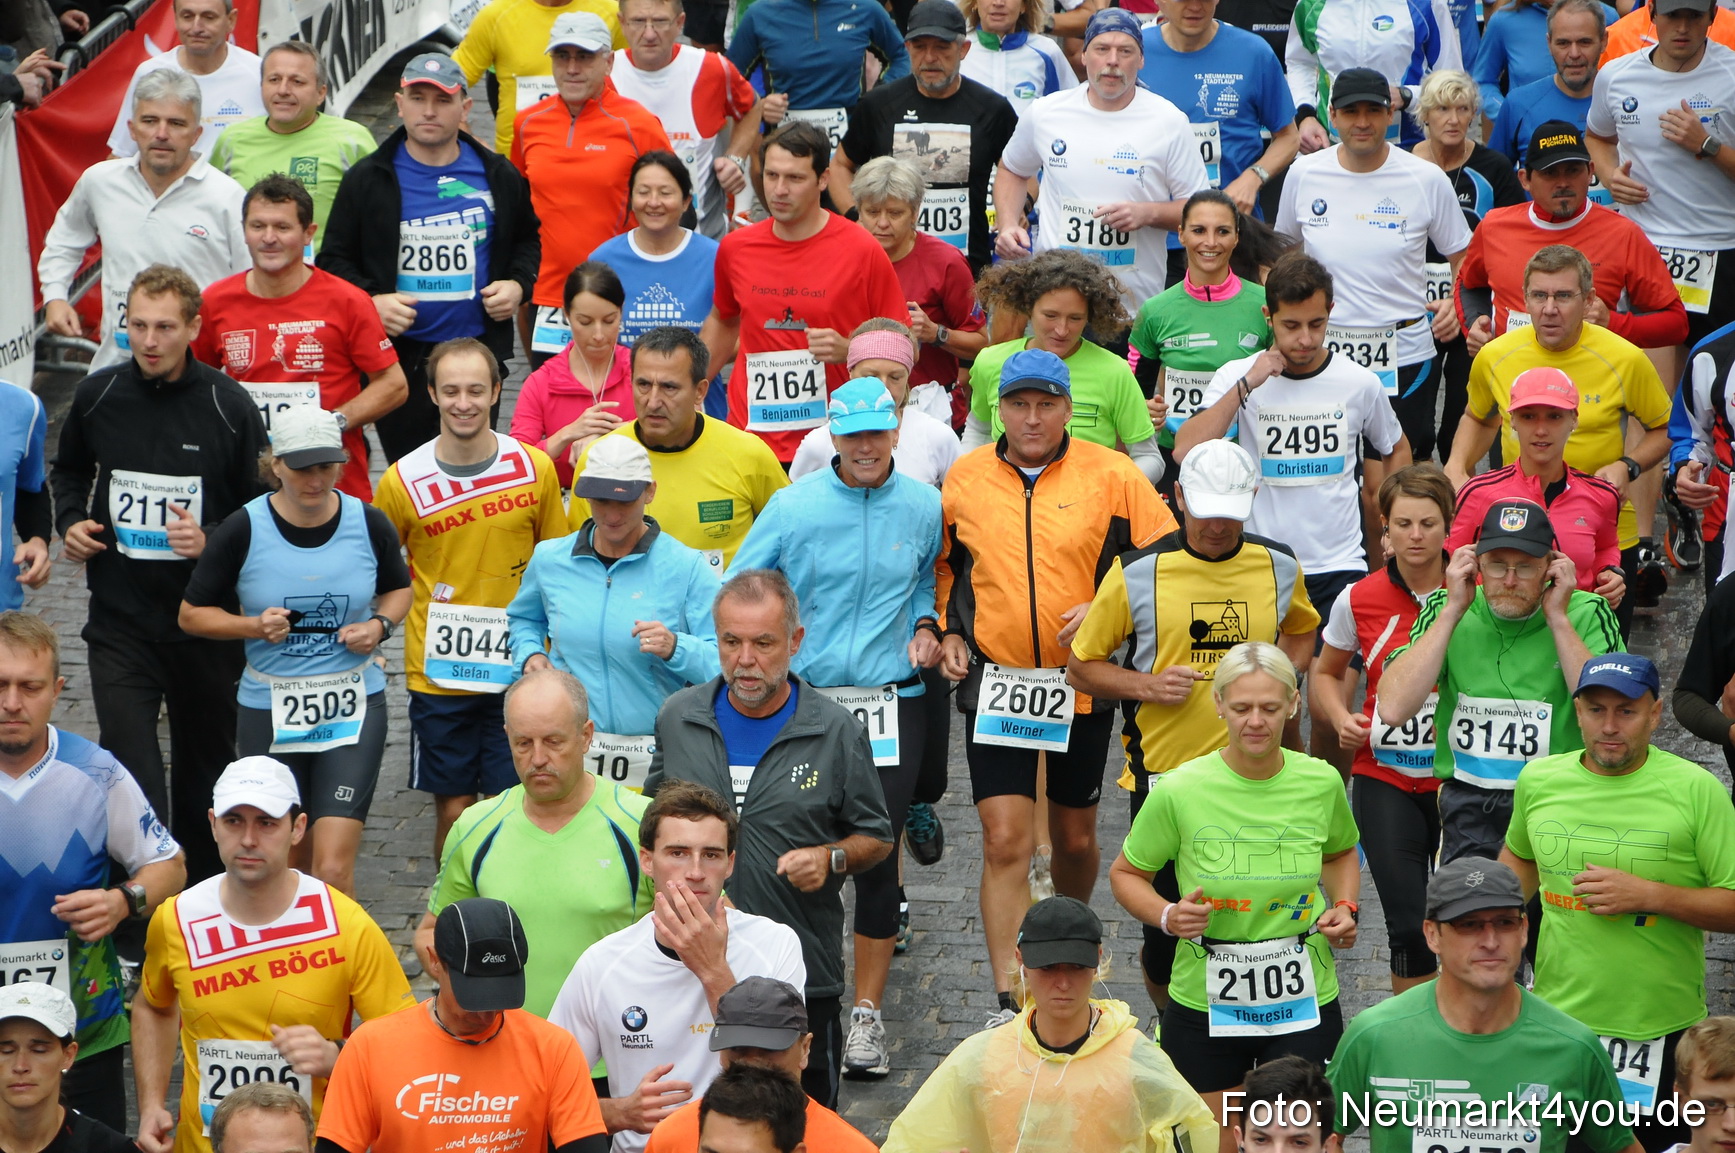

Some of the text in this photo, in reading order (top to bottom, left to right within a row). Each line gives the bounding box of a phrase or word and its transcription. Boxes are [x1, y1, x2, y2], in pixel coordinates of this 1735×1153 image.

[1063, 204, 1086, 215] PARTL
[421, 233, 459, 241] Neumarkt
[401, 244, 468, 271] 2866
[416, 279, 452, 290] Martin
[751, 285, 826, 298] Papa, gib Gas!
[278, 320, 326, 328] NEUMARKTER
[625, 319, 670, 327] Neumarkter
[1345, 331, 1383, 339] Neumarkt
[227, 350, 250, 361] NEU
[748, 358, 808, 368] PARTL Neumarkt
[754, 369, 818, 400] 2164
[1167, 374, 1190, 385] PARTL
[762, 407, 811, 422] Benjamin
[1259, 412, 1331, 422] PARTL Neumarkt
[1266, 424, 1339, 455] 2495
[1277, 462, 1329, 475] Christian
[112, 478, 184, 494] PARTL Neumarkt
[117, 492, 192, 527] 2117
[423, 491, 539, 538] MAX BÖGL
[131, 533, 170, 548] Tobias
[429, 611, 506, 625] PARTL Neumarkt
[285, 633, 340, 645] HIRSCH
[435, 624, 512, 660] 3044
[451, 664, 490, 680] Stefan
[1588, 662, 1633, 675] QUELLE.
[273, 676, 349, 691] PARTL Neumarkt
[985, 671, 1061, 685] PARTL Neumarkt
[836, 694, 880, 704] Neumarkt
[988, 682, 1067, 720] 2602
[283, 688, 357, 726] 2503
[1484, 707, 1533, 719] Neumarkt
[1001, 720, 1045, 737] Werner
[1456, 718, 1539, 757] 3143
[598, 741, 643, 753] Neumarkt
[1222, 872, 1235, 881] und
[1235, 872, 1309, 881] Automatisierungstechnik
[1543, 890, 1587, 911] MERZ
[1209, 947, 1292, 964] PARTL Neumarkt
[192, 947, 346, 998] MAX BÖGL
[1218, 960, 1305, 1002] 2103
[1233, 1007, 1293, 1023] Theresia
[620, 1034, 653, 1043] PARTL
[199, 1046, 232, 1060] PARTL
[621, 1042, 654, 1050] Neumarkt
[418, 1090, 520, 1113] Fischer
[428, 1113, 511, 1125] AUTOMOBILE
[468, 1132, 488, 1144] das
[1416, 1127, 1519, 1142] PARTL Neumarkt
